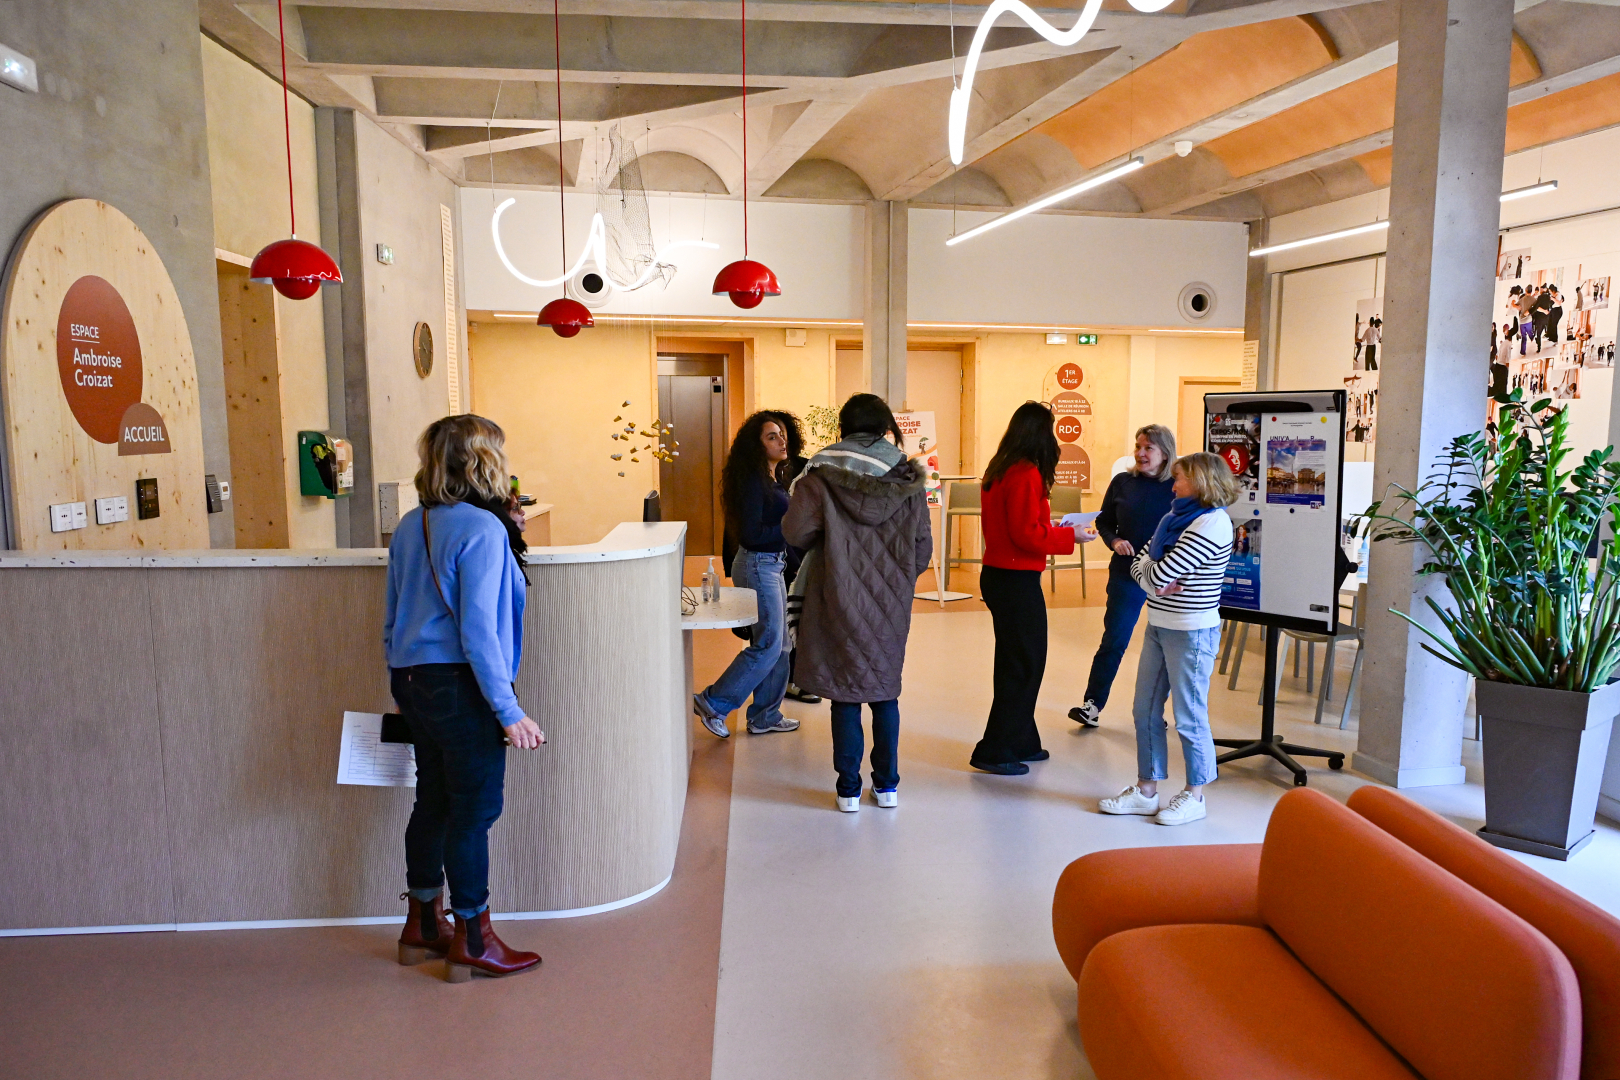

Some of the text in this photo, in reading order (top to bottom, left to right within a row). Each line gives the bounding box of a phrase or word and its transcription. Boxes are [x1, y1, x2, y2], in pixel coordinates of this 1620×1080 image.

[71, 324, 99, 338] ESPACE
[74, 347, 122, 368] Ambroise
[75, 369, 113, 387] Croizat
[1065, 369, 1076, 378] 1ER
[124, 426, 164, 442] ACCUEIL
[1058, 426, 1080, 434] RDC
